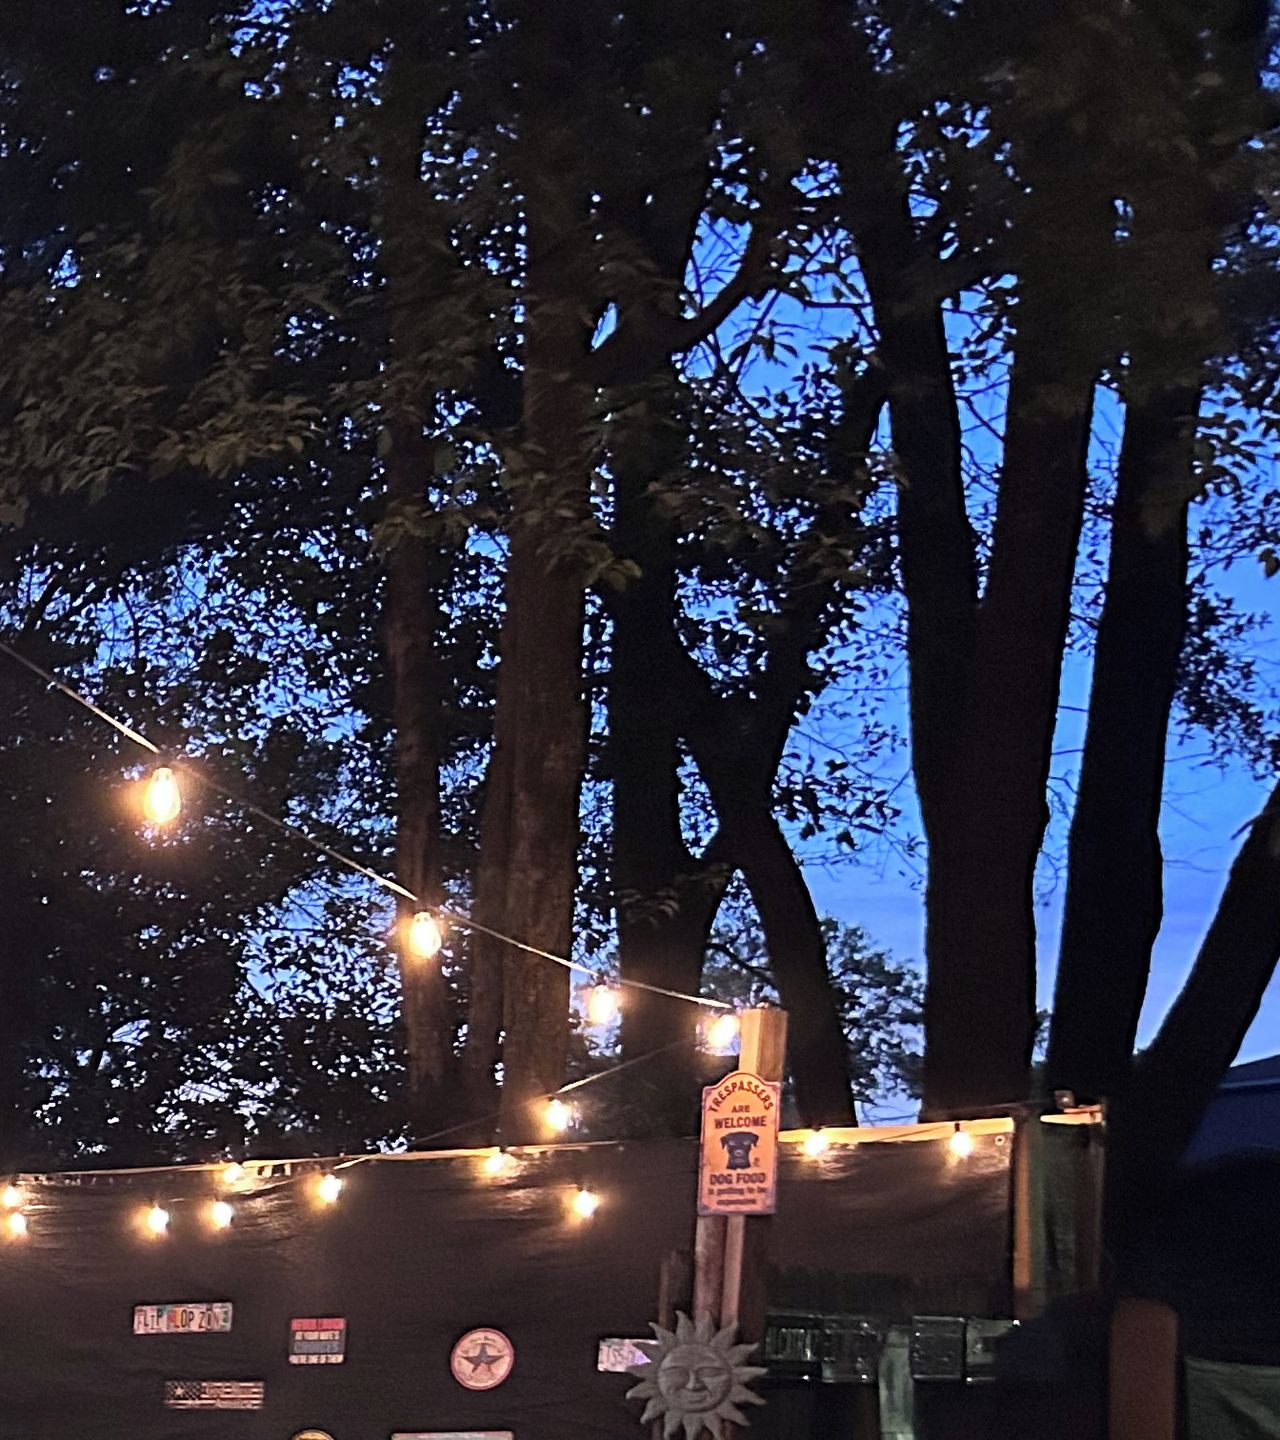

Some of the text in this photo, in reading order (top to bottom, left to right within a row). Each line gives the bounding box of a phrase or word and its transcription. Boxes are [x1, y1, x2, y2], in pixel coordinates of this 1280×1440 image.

[708, 1080, 774, 1112] TRESPASSERS
[731, 1105, 750, 1113] ARE
[714, 1116, 767, 1129] WELCOME
[710, 1172, 766, 1185] DOG FOOD
[136, 1308, 163, 1330] FLIP
[199, 1308, 229, 1330] ZONE
